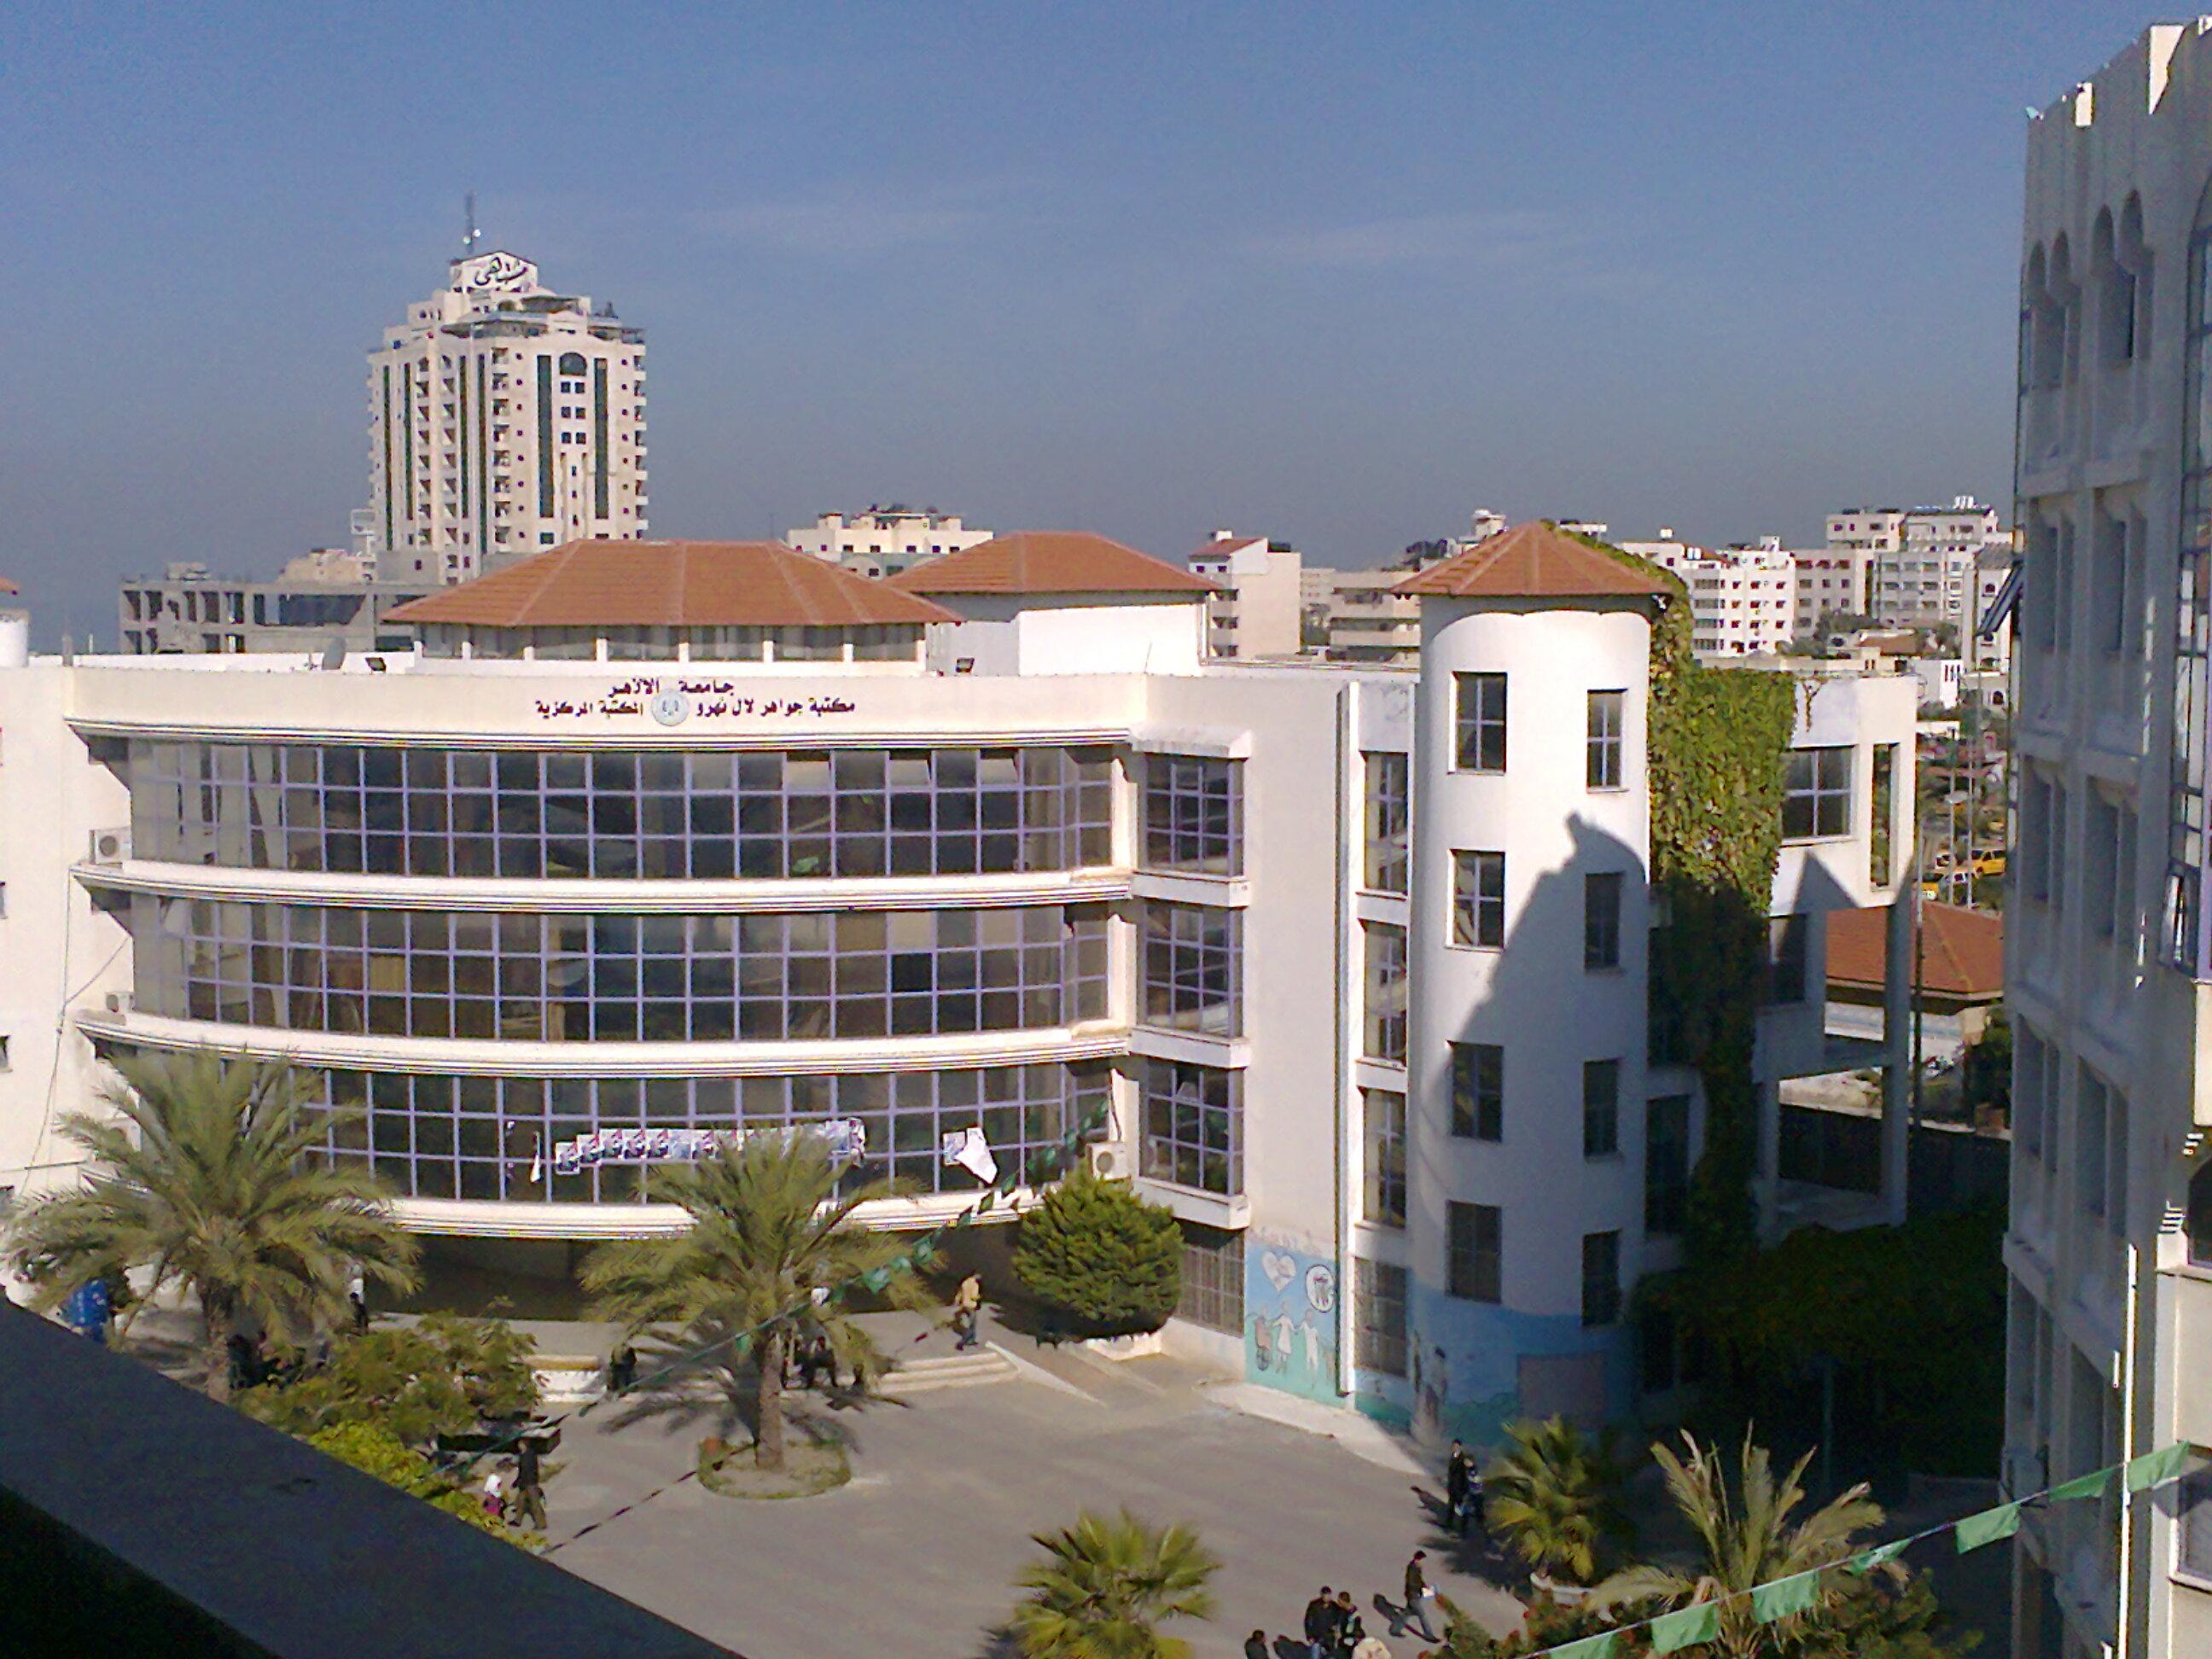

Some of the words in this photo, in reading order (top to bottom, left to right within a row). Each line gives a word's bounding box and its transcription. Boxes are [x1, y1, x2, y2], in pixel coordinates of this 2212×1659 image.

[678, 678, 735, 696] جامعة
[535, 700, 593, 719] المركزية
[599, 700, 643, 720] المكتبة
[696, 696, 727, 717] نهرو
[732, 697, 754, 716] لال
[760, 697, 803, 717] جواهر
[808, 696, 855, 717] مكتبة
